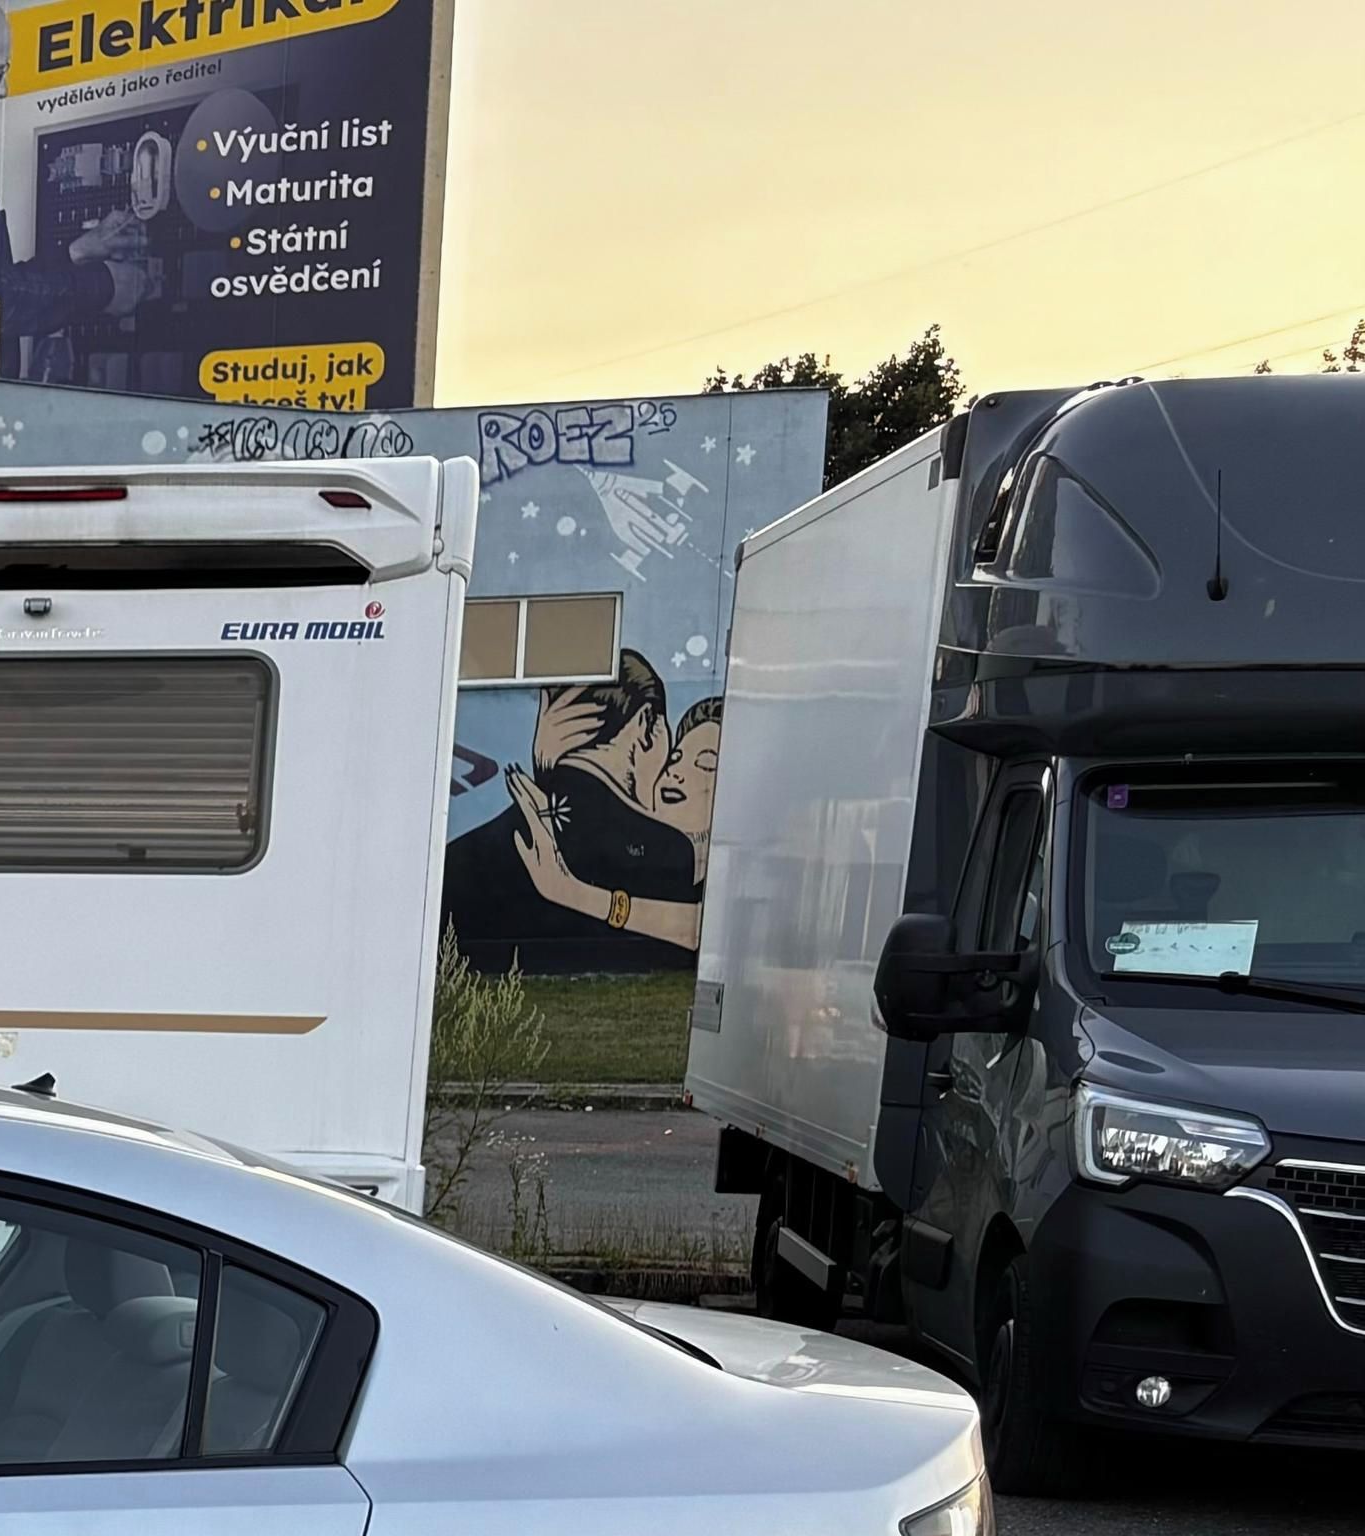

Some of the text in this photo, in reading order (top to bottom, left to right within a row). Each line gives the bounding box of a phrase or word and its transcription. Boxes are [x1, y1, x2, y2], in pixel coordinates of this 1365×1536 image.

[37, 0, 364, 73] Elektrik
[36, 57, 223, 114] vydělává jako ředitel
[212, 117, 393, 164] Výuční list
[225, 169, 374, 208] Maturita
[245, 219, 350, 255] Státní
[209, 258, 382, 299] osvědčení
[212, 352, 374, 385] Studuj, jak
[220, 621, 385, 640] EURA MOBIL
